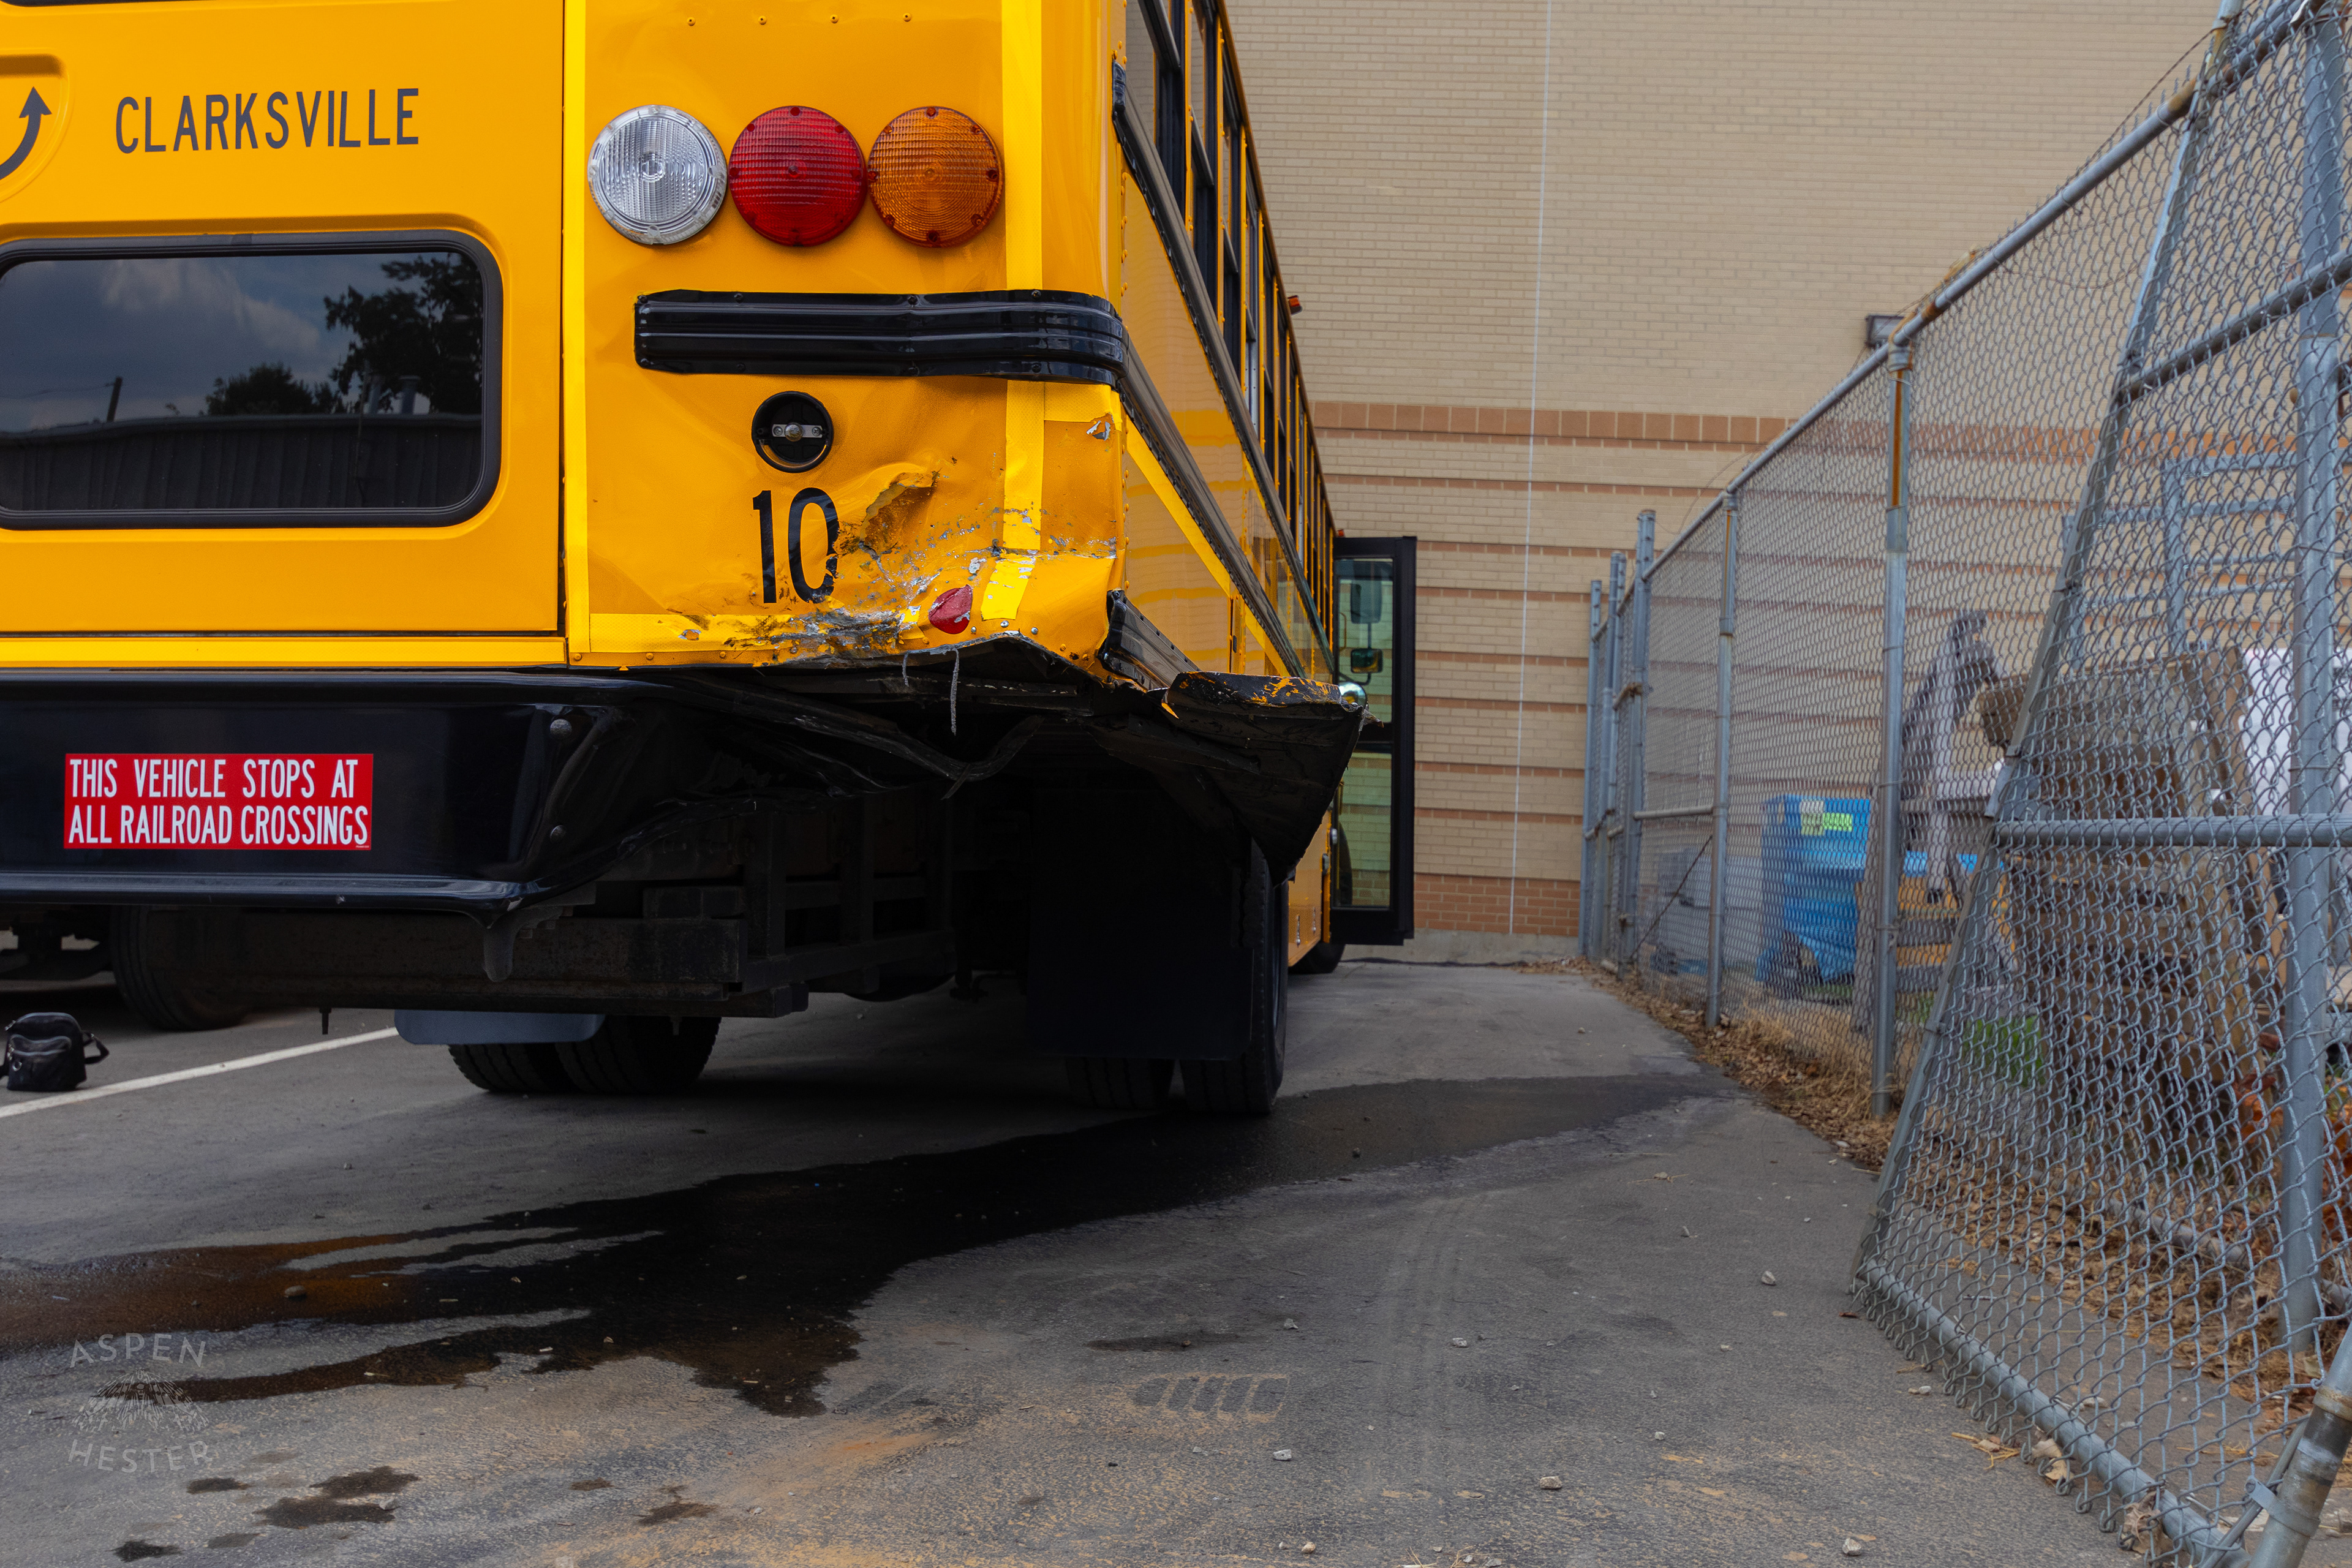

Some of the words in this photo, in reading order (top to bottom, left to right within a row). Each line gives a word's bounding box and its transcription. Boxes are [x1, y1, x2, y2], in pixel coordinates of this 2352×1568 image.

[116, 88, 419, 154] CLARKSVILLE
[753, 487, 840, 604] 10
[70, 758, 118, 797] THIS
[134, 758, 226, 797] VEHICLE
[243, 758, 315, 798] STOPS
[331, 759, 358, 798] AT
[68, 805, 112, 843] ALL
[120, 805, 232, 844] RAILROAD
[241, 805, 368, 845] CROSSINGS
